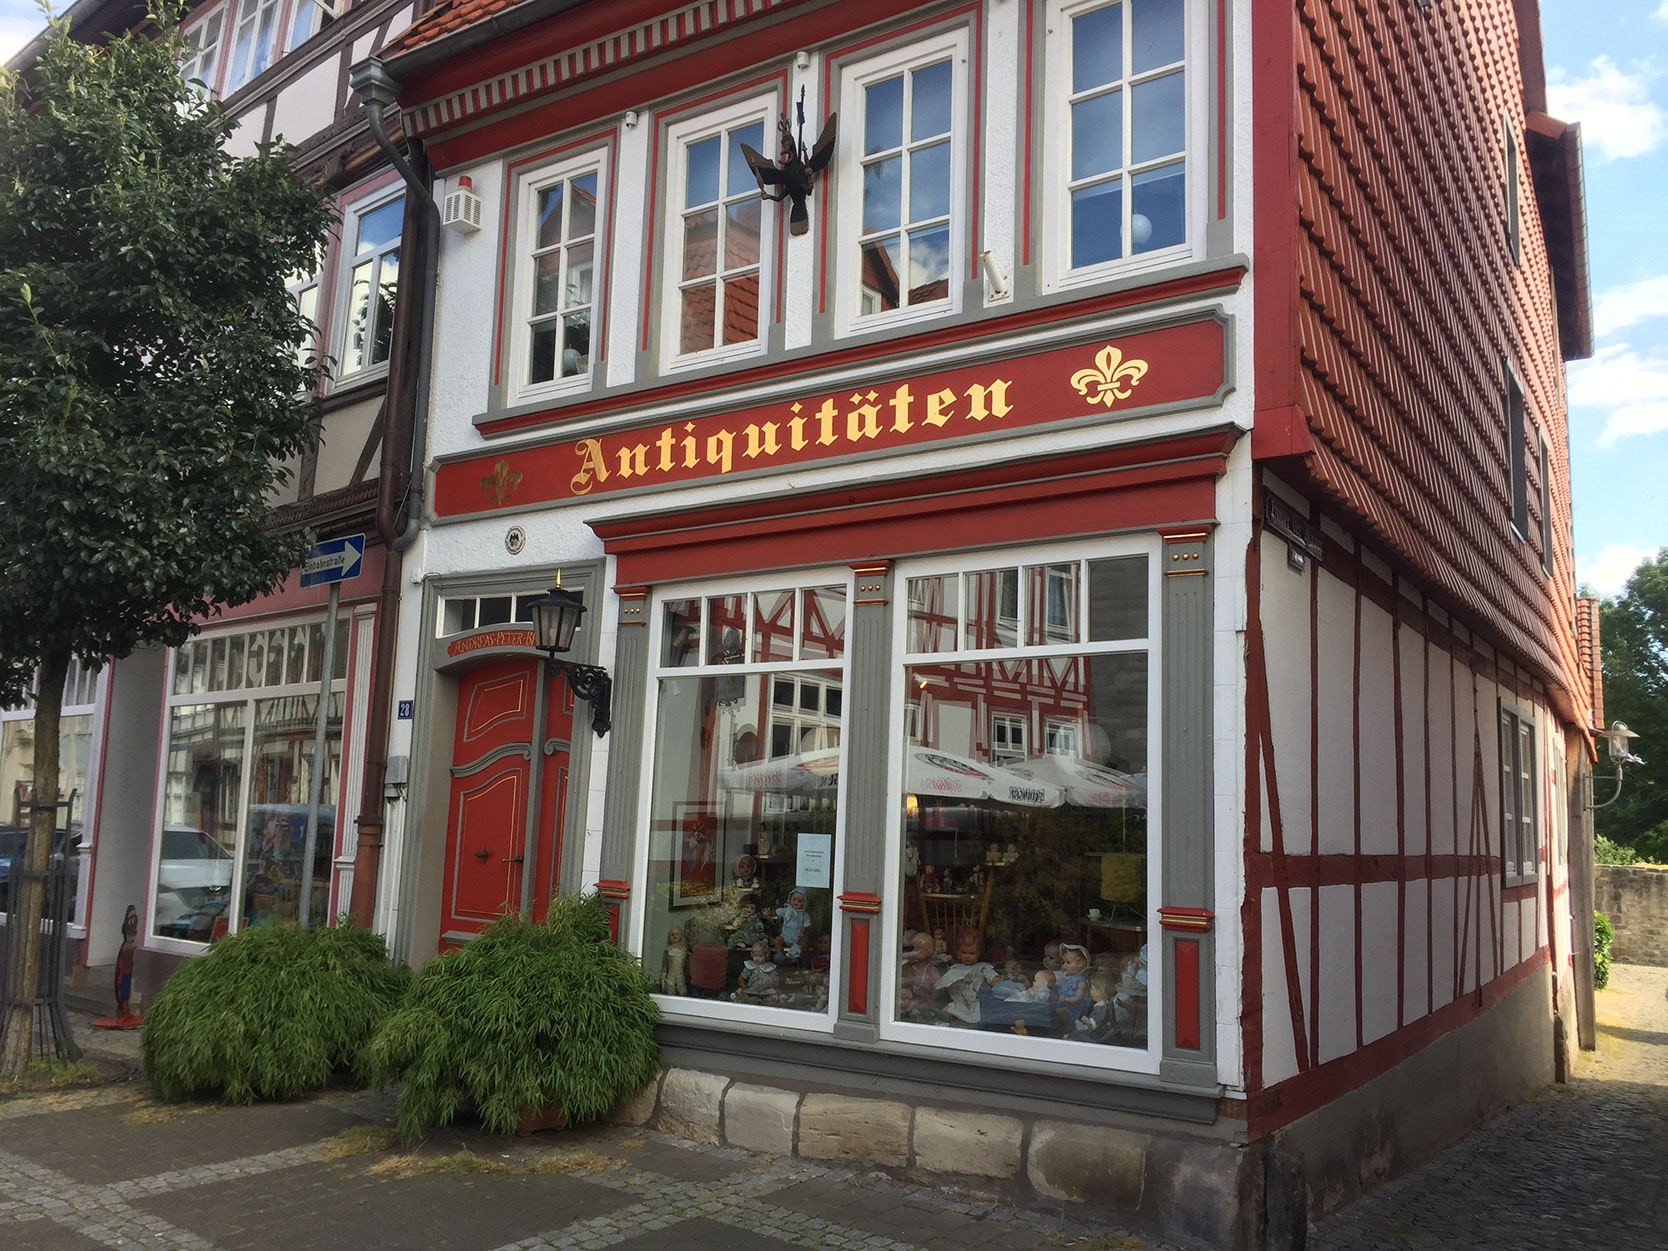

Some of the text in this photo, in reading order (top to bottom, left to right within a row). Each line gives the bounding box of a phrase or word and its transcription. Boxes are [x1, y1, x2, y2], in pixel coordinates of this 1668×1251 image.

[569, 378, 1015, 496] Antiquitäten
[304, 555, 346, 572] Einbahnstraße
[400, 703, 410, 717] 28
